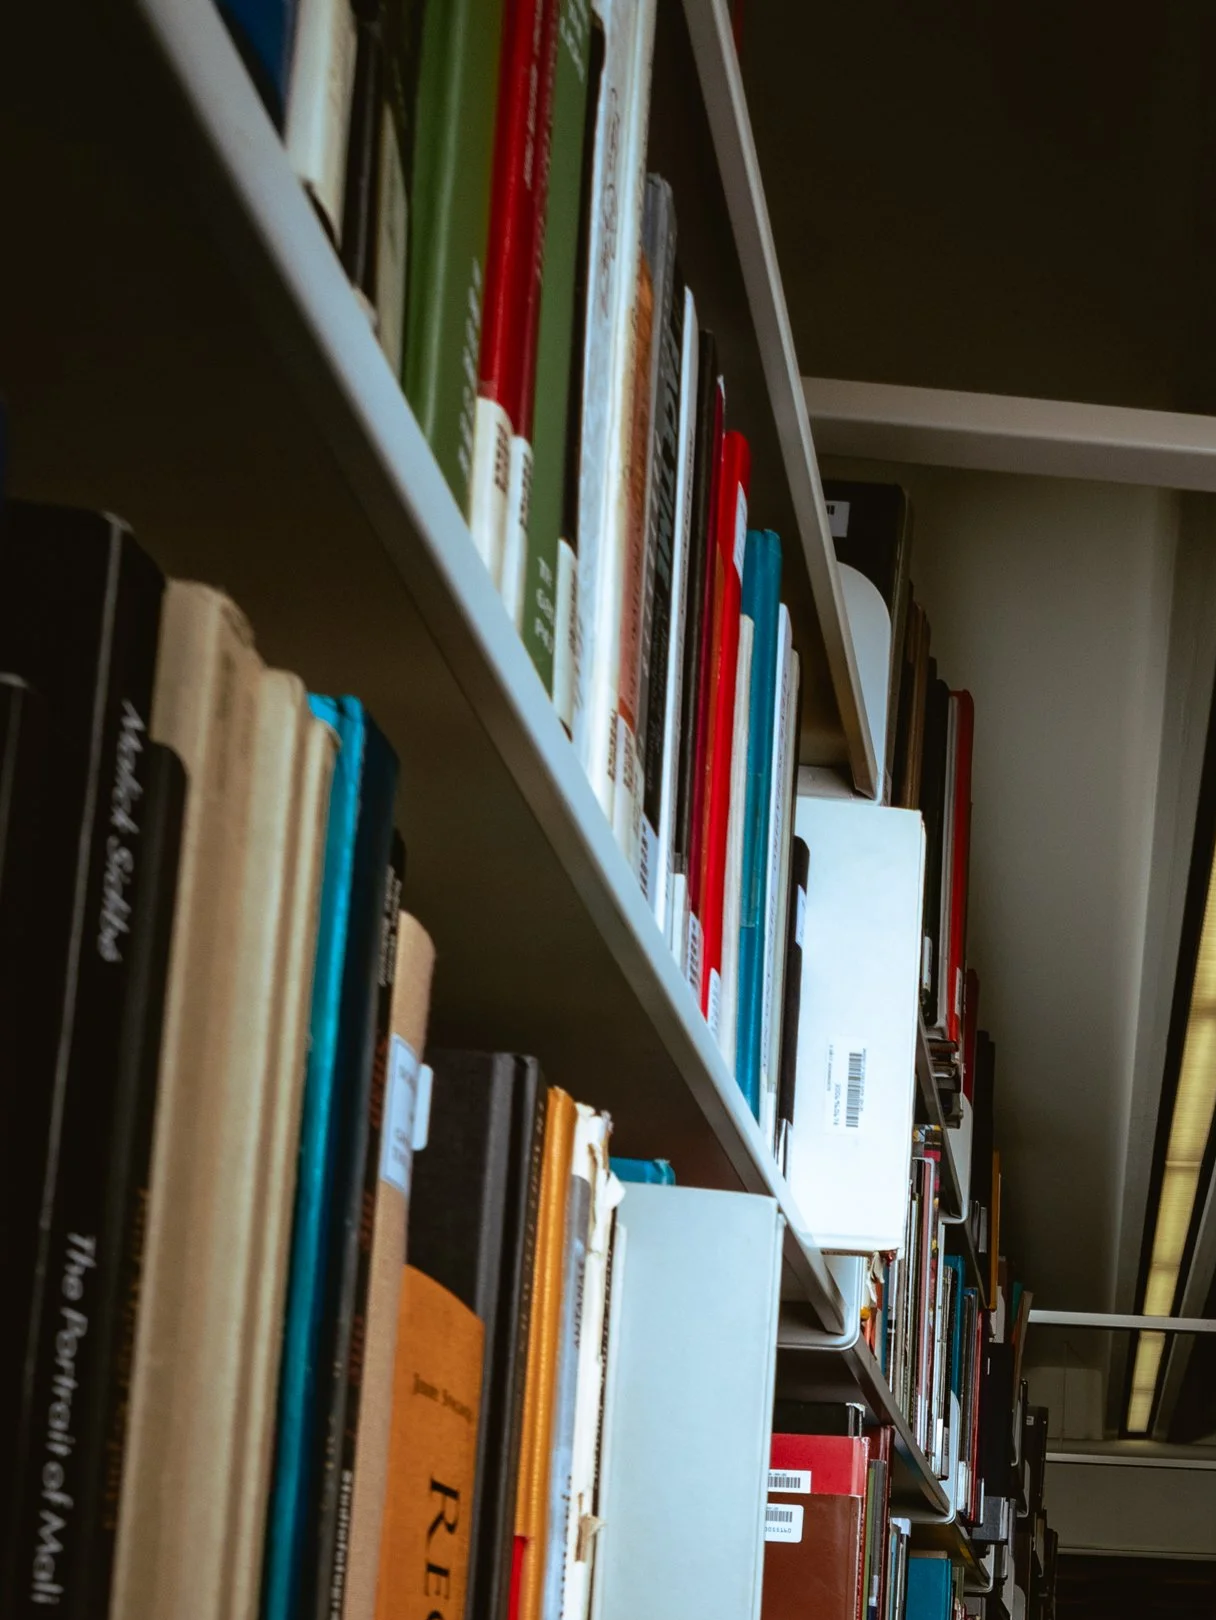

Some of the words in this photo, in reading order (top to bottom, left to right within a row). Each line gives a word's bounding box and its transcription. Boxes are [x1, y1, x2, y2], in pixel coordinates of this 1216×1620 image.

[62, 1231, 98, 1302] The
[45, 1306, 90, 1458] Portrait
[42, 1460, 75, 1511] of
[29, 1510, 68, 1606] Mali
